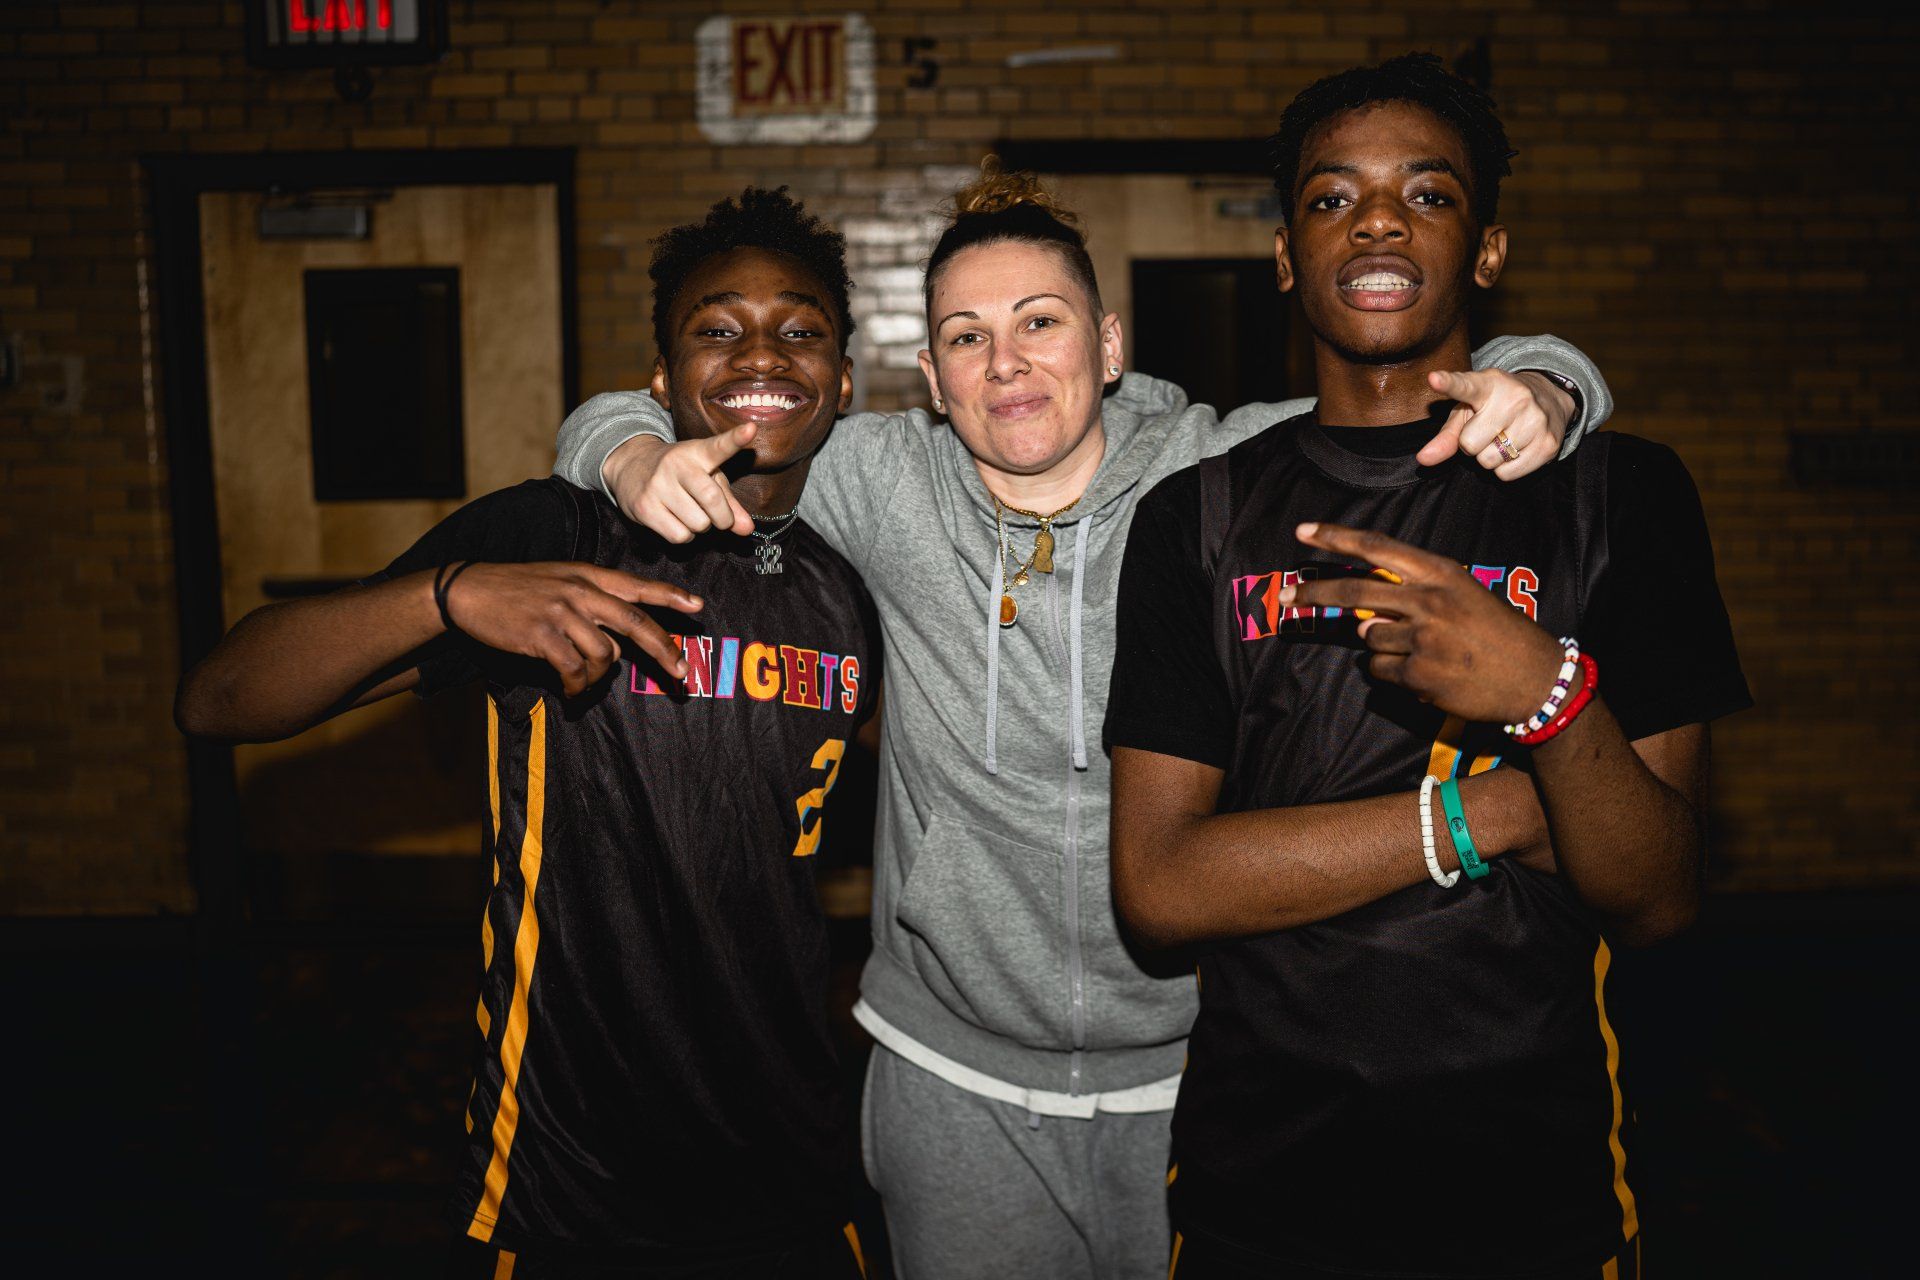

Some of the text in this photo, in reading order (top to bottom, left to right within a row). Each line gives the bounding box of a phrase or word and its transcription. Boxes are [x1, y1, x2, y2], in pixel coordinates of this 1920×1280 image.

[736, 22, 842, 102] EXIT
[903, 37, 938, 88] 5
[755, 544, 783, 575] 32
[792, 738, 846, 857] 2
